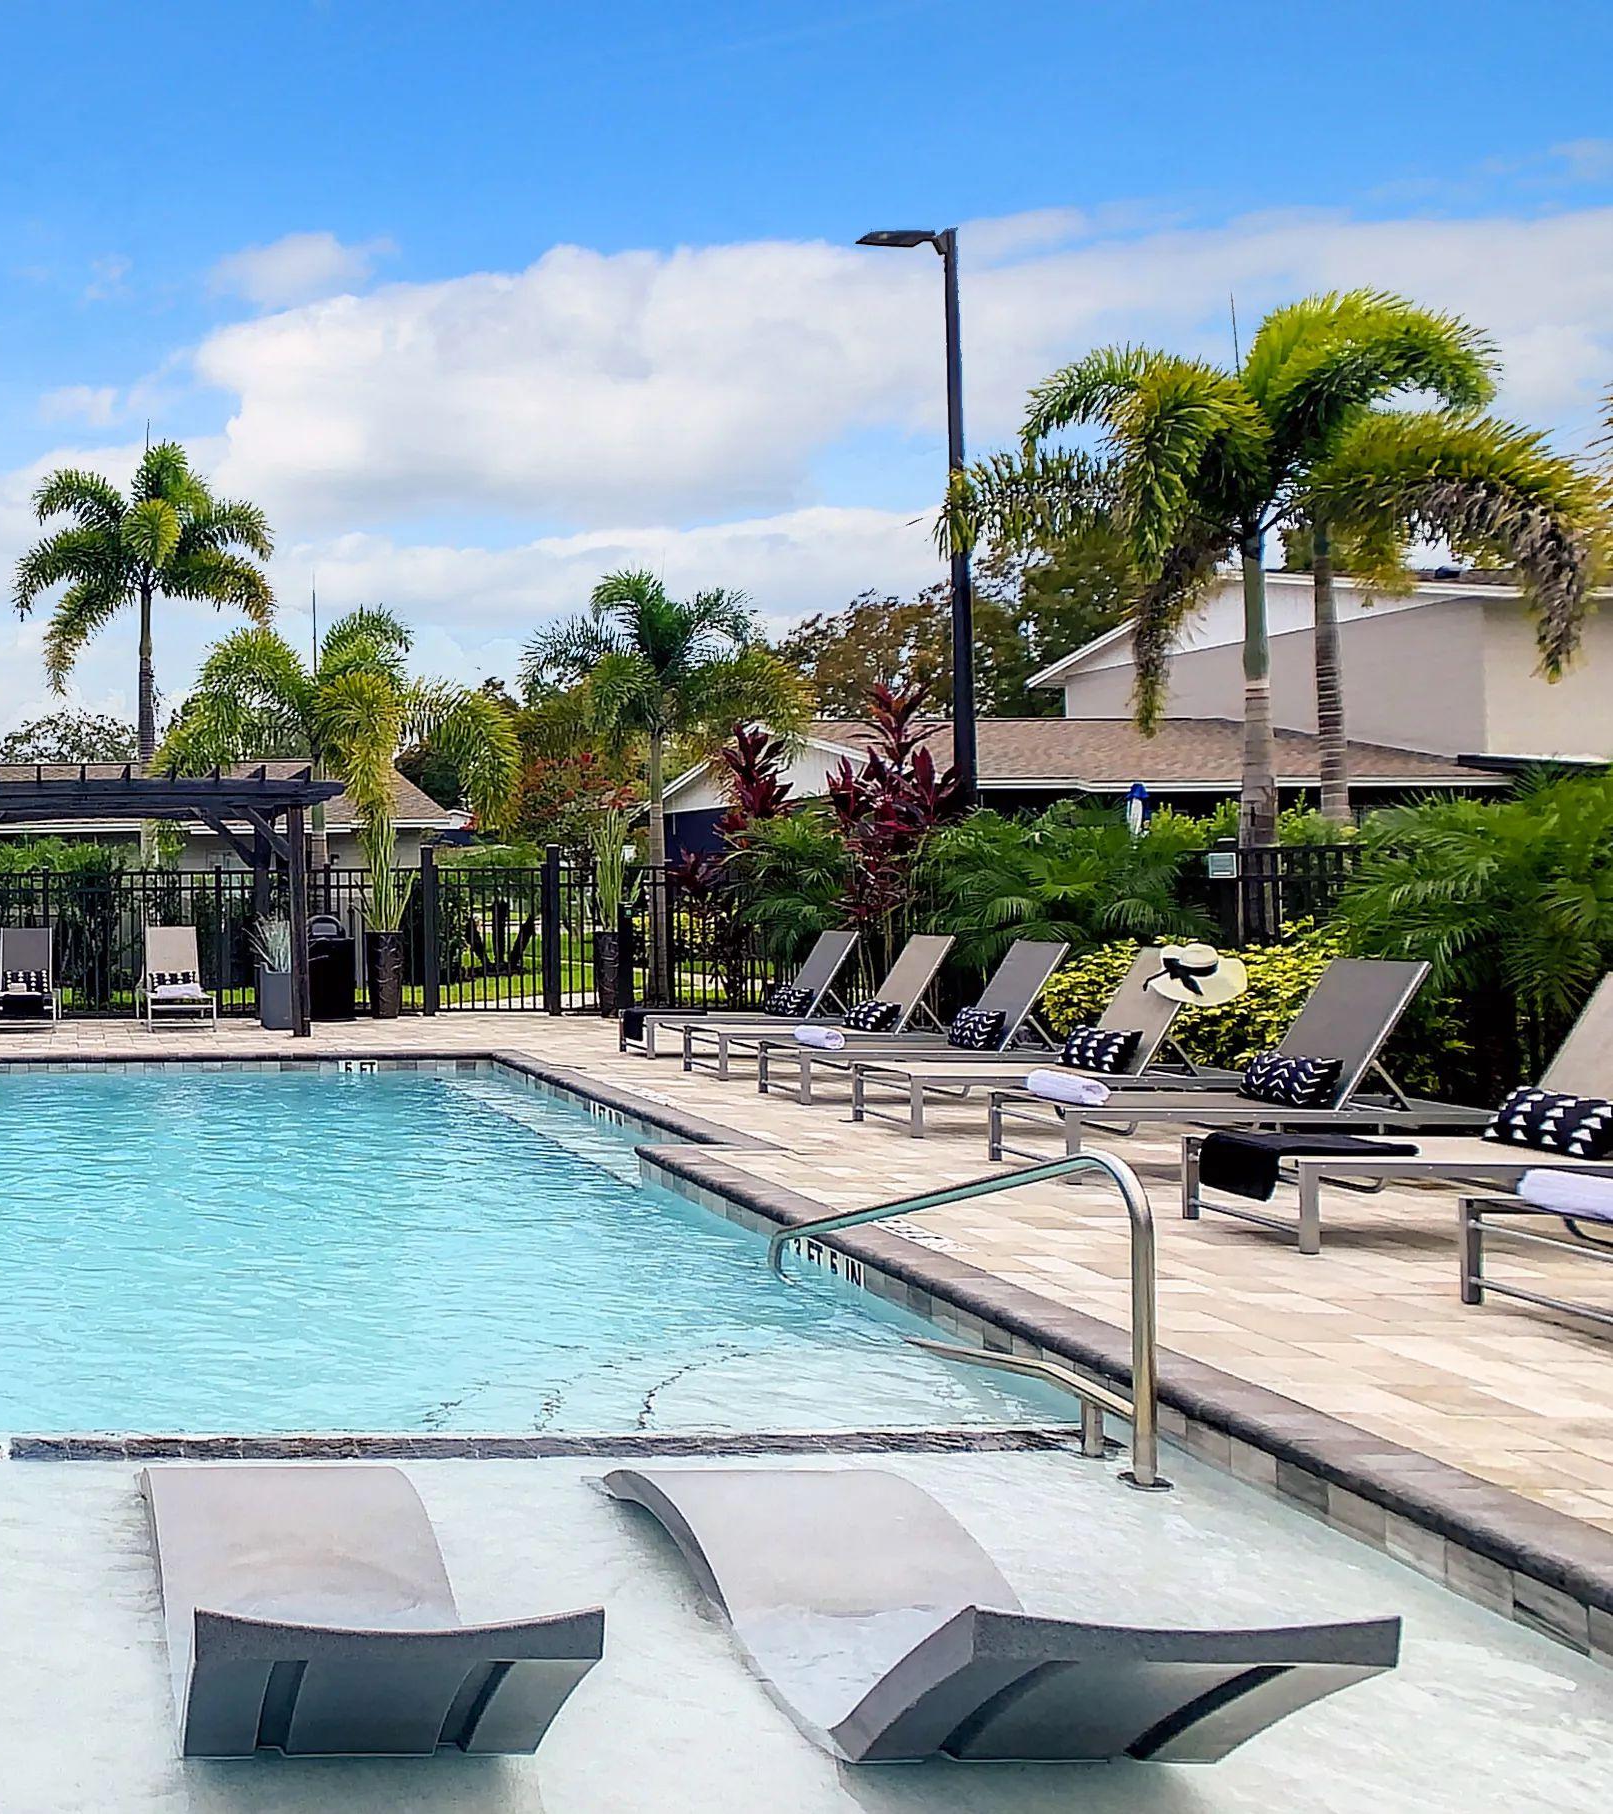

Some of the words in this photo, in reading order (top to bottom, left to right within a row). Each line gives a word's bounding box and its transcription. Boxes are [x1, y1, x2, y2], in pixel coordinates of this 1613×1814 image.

[359, 1061, 376, 1073] FT
[807, 1239, 823, 1266] FT
[830, 1250, 838, 1275] 5
[845, 1257, 861, 1288] IN
